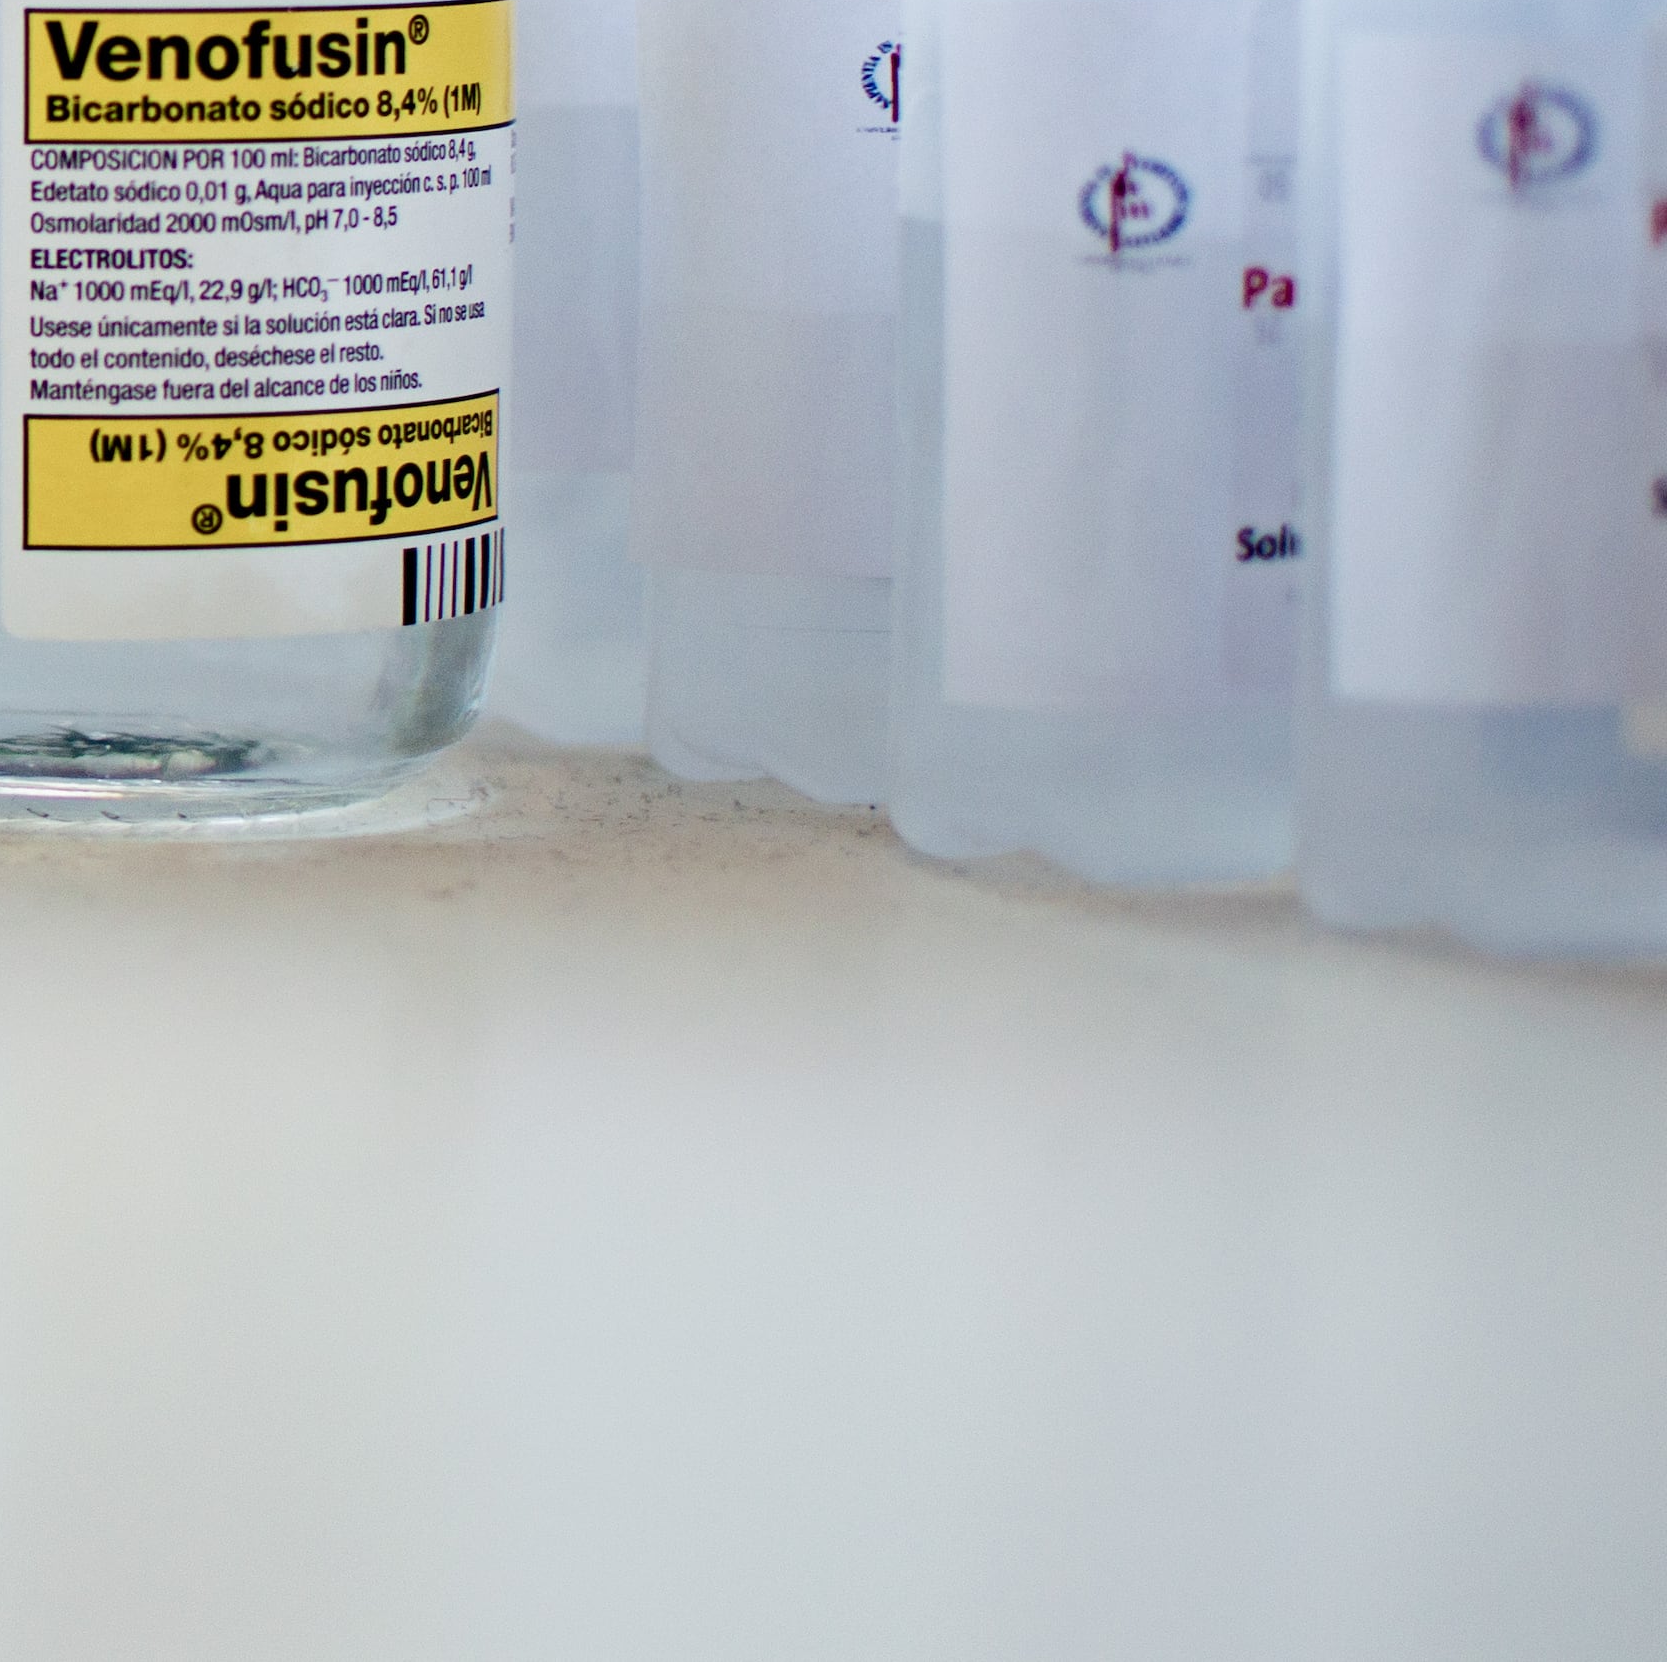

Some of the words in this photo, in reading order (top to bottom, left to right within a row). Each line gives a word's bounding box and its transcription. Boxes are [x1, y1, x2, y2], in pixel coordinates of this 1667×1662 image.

[45, 95, 262, 124] Bicarbonato
[268, 88, 370, 121] sódico
[375, 87, 438, 123] 8,4%
[442, 82, 482, 119] (1M)
[30, 148, 177, 171] COMPOSICION
[183, 149, 224, 170] POR
[231, 148, 265, 169] 100
[270, 148, 299, 168] ml:
[302, 143, 401, 168] Bicarbonato
[403, 141, 446, 164] sódico
[30, 180, 109, 203] Edetato
[113, 179, 181, 202] sódico
[185, 180, 228, 204] 0,01
[254, 180, 303, 203] Aqua
[306, 181, 346, 203] para
[350, 172, 421, 201] inyección
[462, 166, 481, 189] 100
[30, 211, 161, 234] Osmolaridad
[165, 212, 217, 233] 2000
[305, 208, 328, 234] pH
[333, 207, 359, 232] 7,0
[373, 205, 398, 230] 8,5
[30, 248, 194, 270] ELECTROLITOS:
[74, 279, 125, 302] 1000
[199, 278, 244, 303] 22,9
[344, 273, 383, 296] 1000
[432, 266, 456, 290] 61,1
[30, 315, 92, 339] Usese
[98, 314, 218, 338] únicamente
[222, 314, 240, 336] si
[244, 314, 261, 336] la
[265, 311, 341, 336] solución
[344, 307, 379, 332] está
[382, 307, 421, 329] clara.
[424, 303, 437, 326] Si
[438, 305, 453, 323] no
[454, 305, 467, 321] se
[468, 300, 485, 321] usa
[29, 347, 75, 370] todo
[80, 347, 98, 369] el
[103, 347, 210, 372] contenido,
[214, 344, 316, 368] deséchese
[319, 343, 336, 364] el
[339, 341, 384, 363] resto.
[29, 378, 157, 405] Manténgase
[162, 378, 215, 400] fuera
[219, 377, 250, 400] del
[253, 376, 325, 399] alcance
[329, 373, 350, 395] de
[354, 372, 377, 394] los
[380, 369, 423, 392] niños.
[89, 427, 168, 463] (1M)
[176, 427, 264, 463] 8,4%
[272, 423, 371, 457] sódico
[377, 408, 493, 446] Bicarbonato
